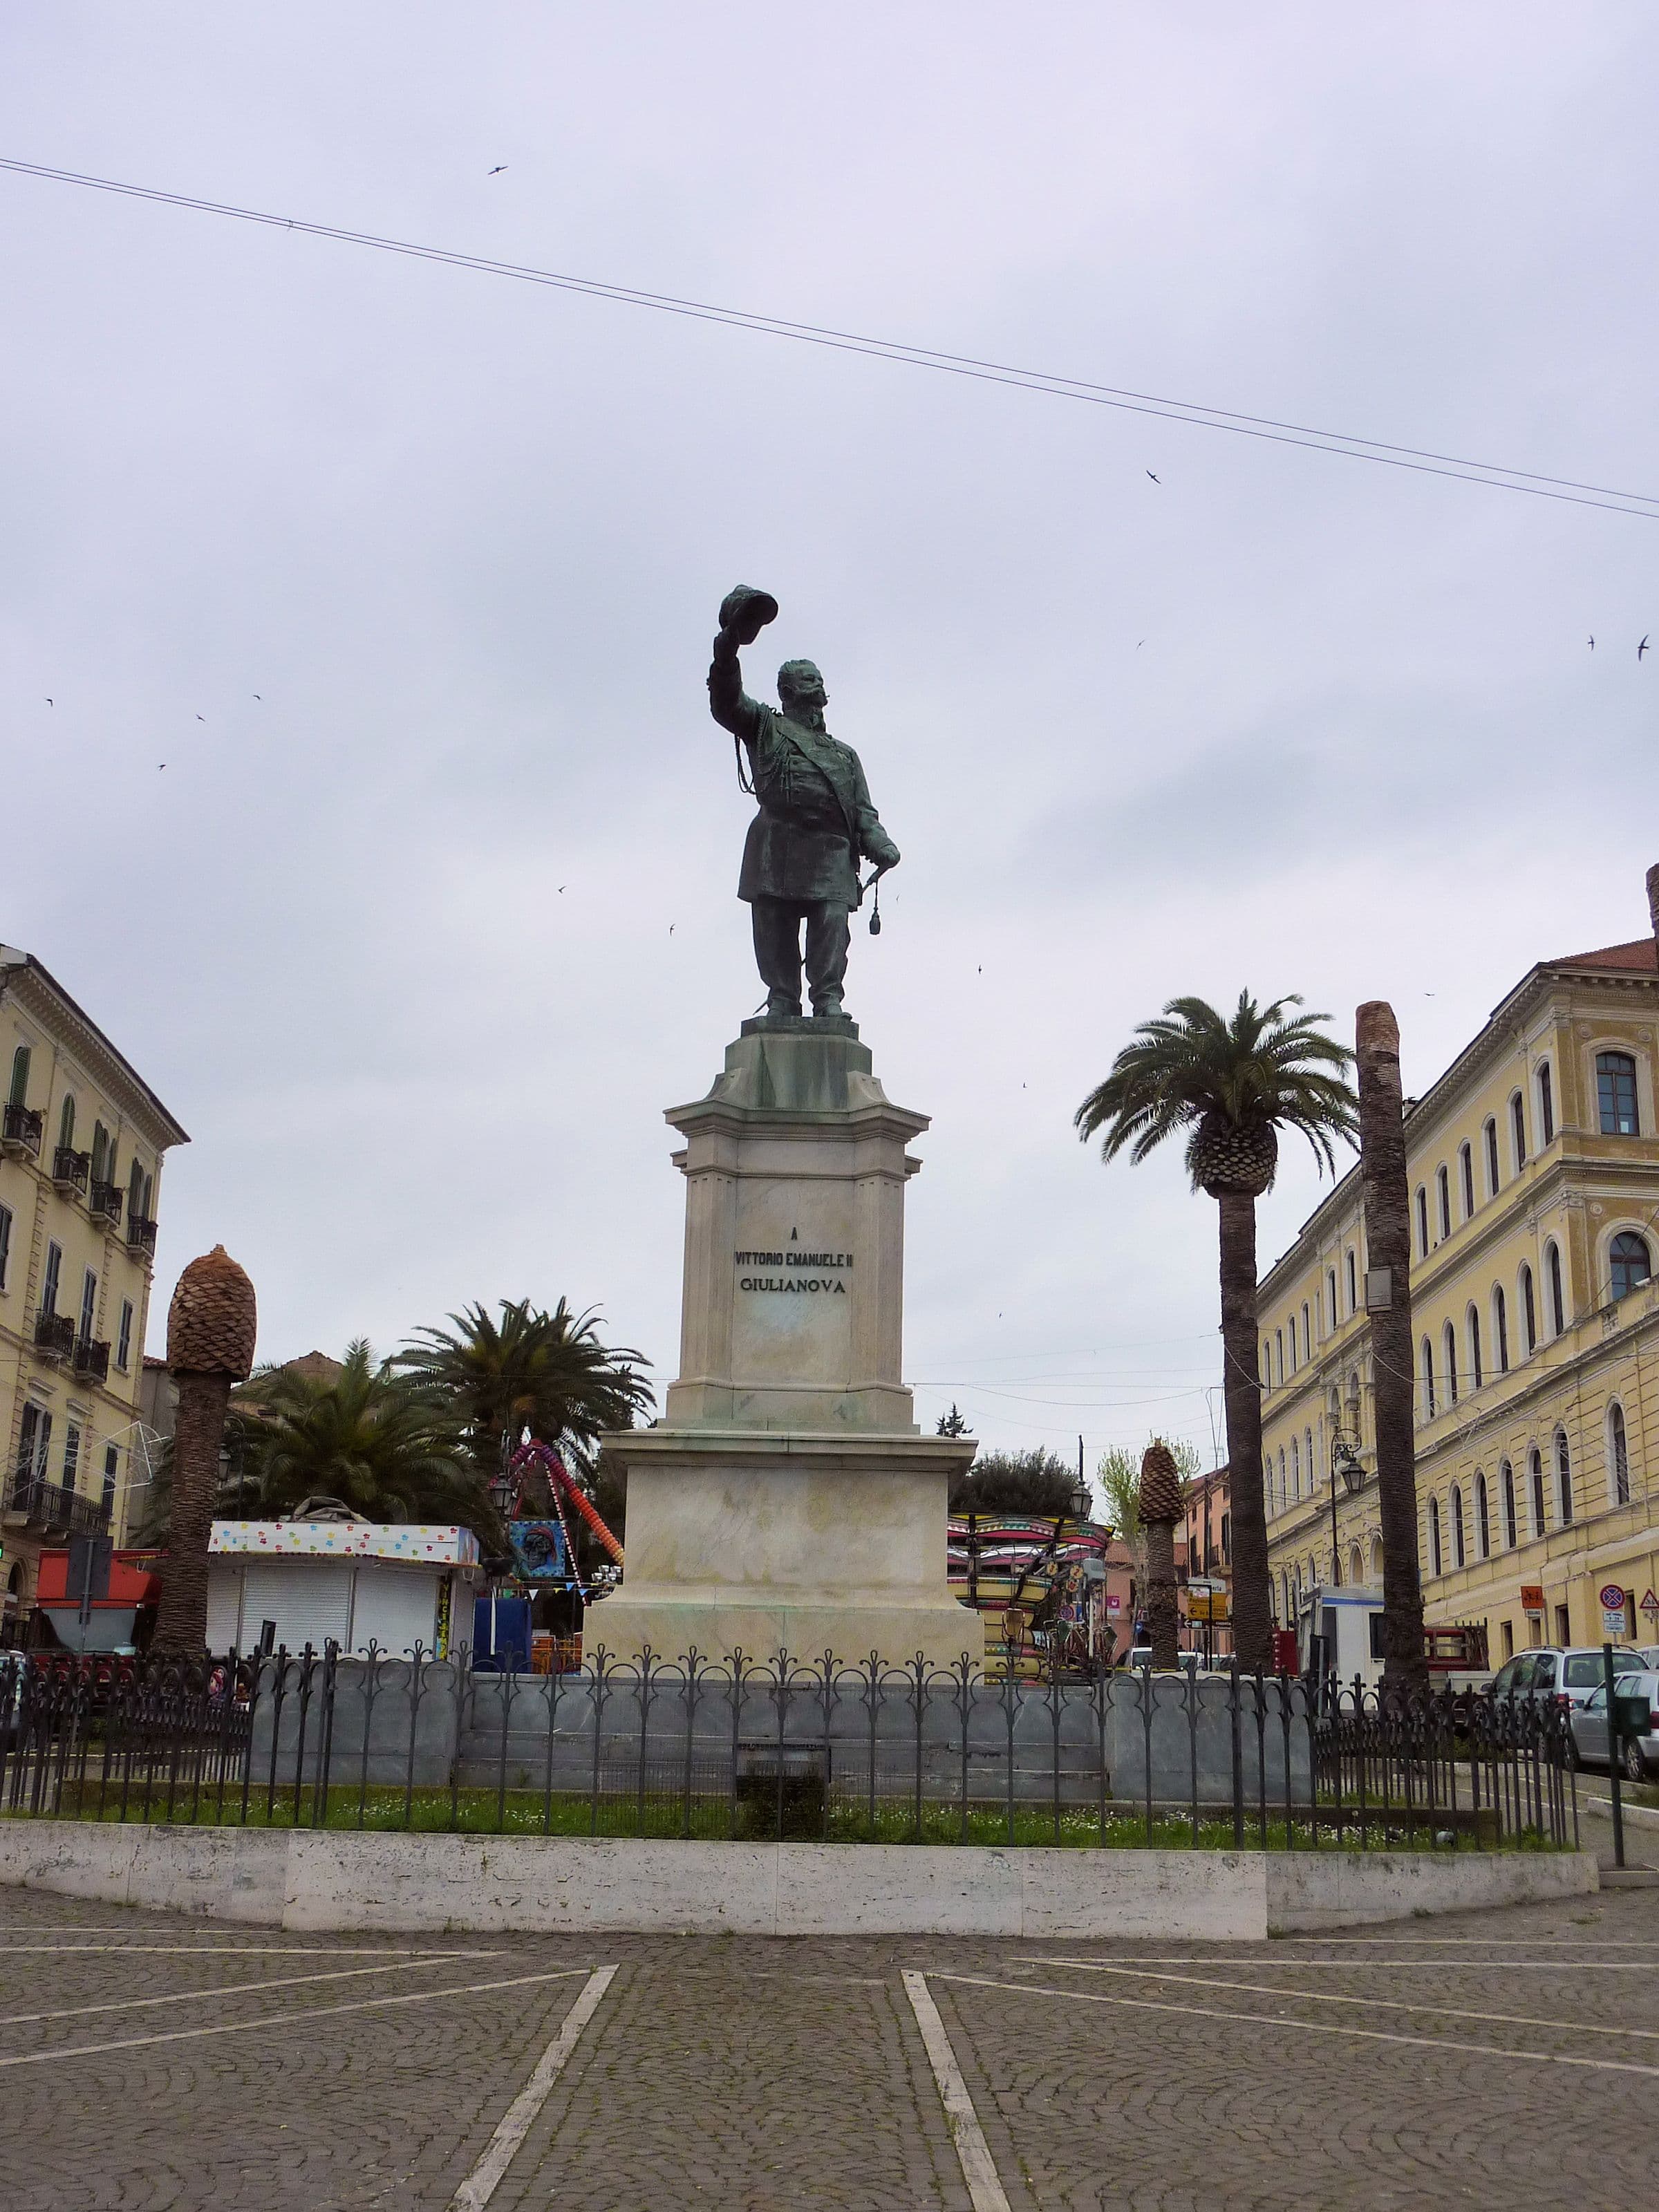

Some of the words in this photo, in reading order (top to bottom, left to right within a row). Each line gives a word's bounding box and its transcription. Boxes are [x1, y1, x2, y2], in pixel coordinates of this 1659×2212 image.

[791, 1227, 798, 1240] A
[735, 1252, 783, 1266] VITTORIO
[786, 1253, 844, 1267] EMANUELE
[847, 1255, 852, 1267] II
[741, 1278, 845, 1293] GIULIANOVA
